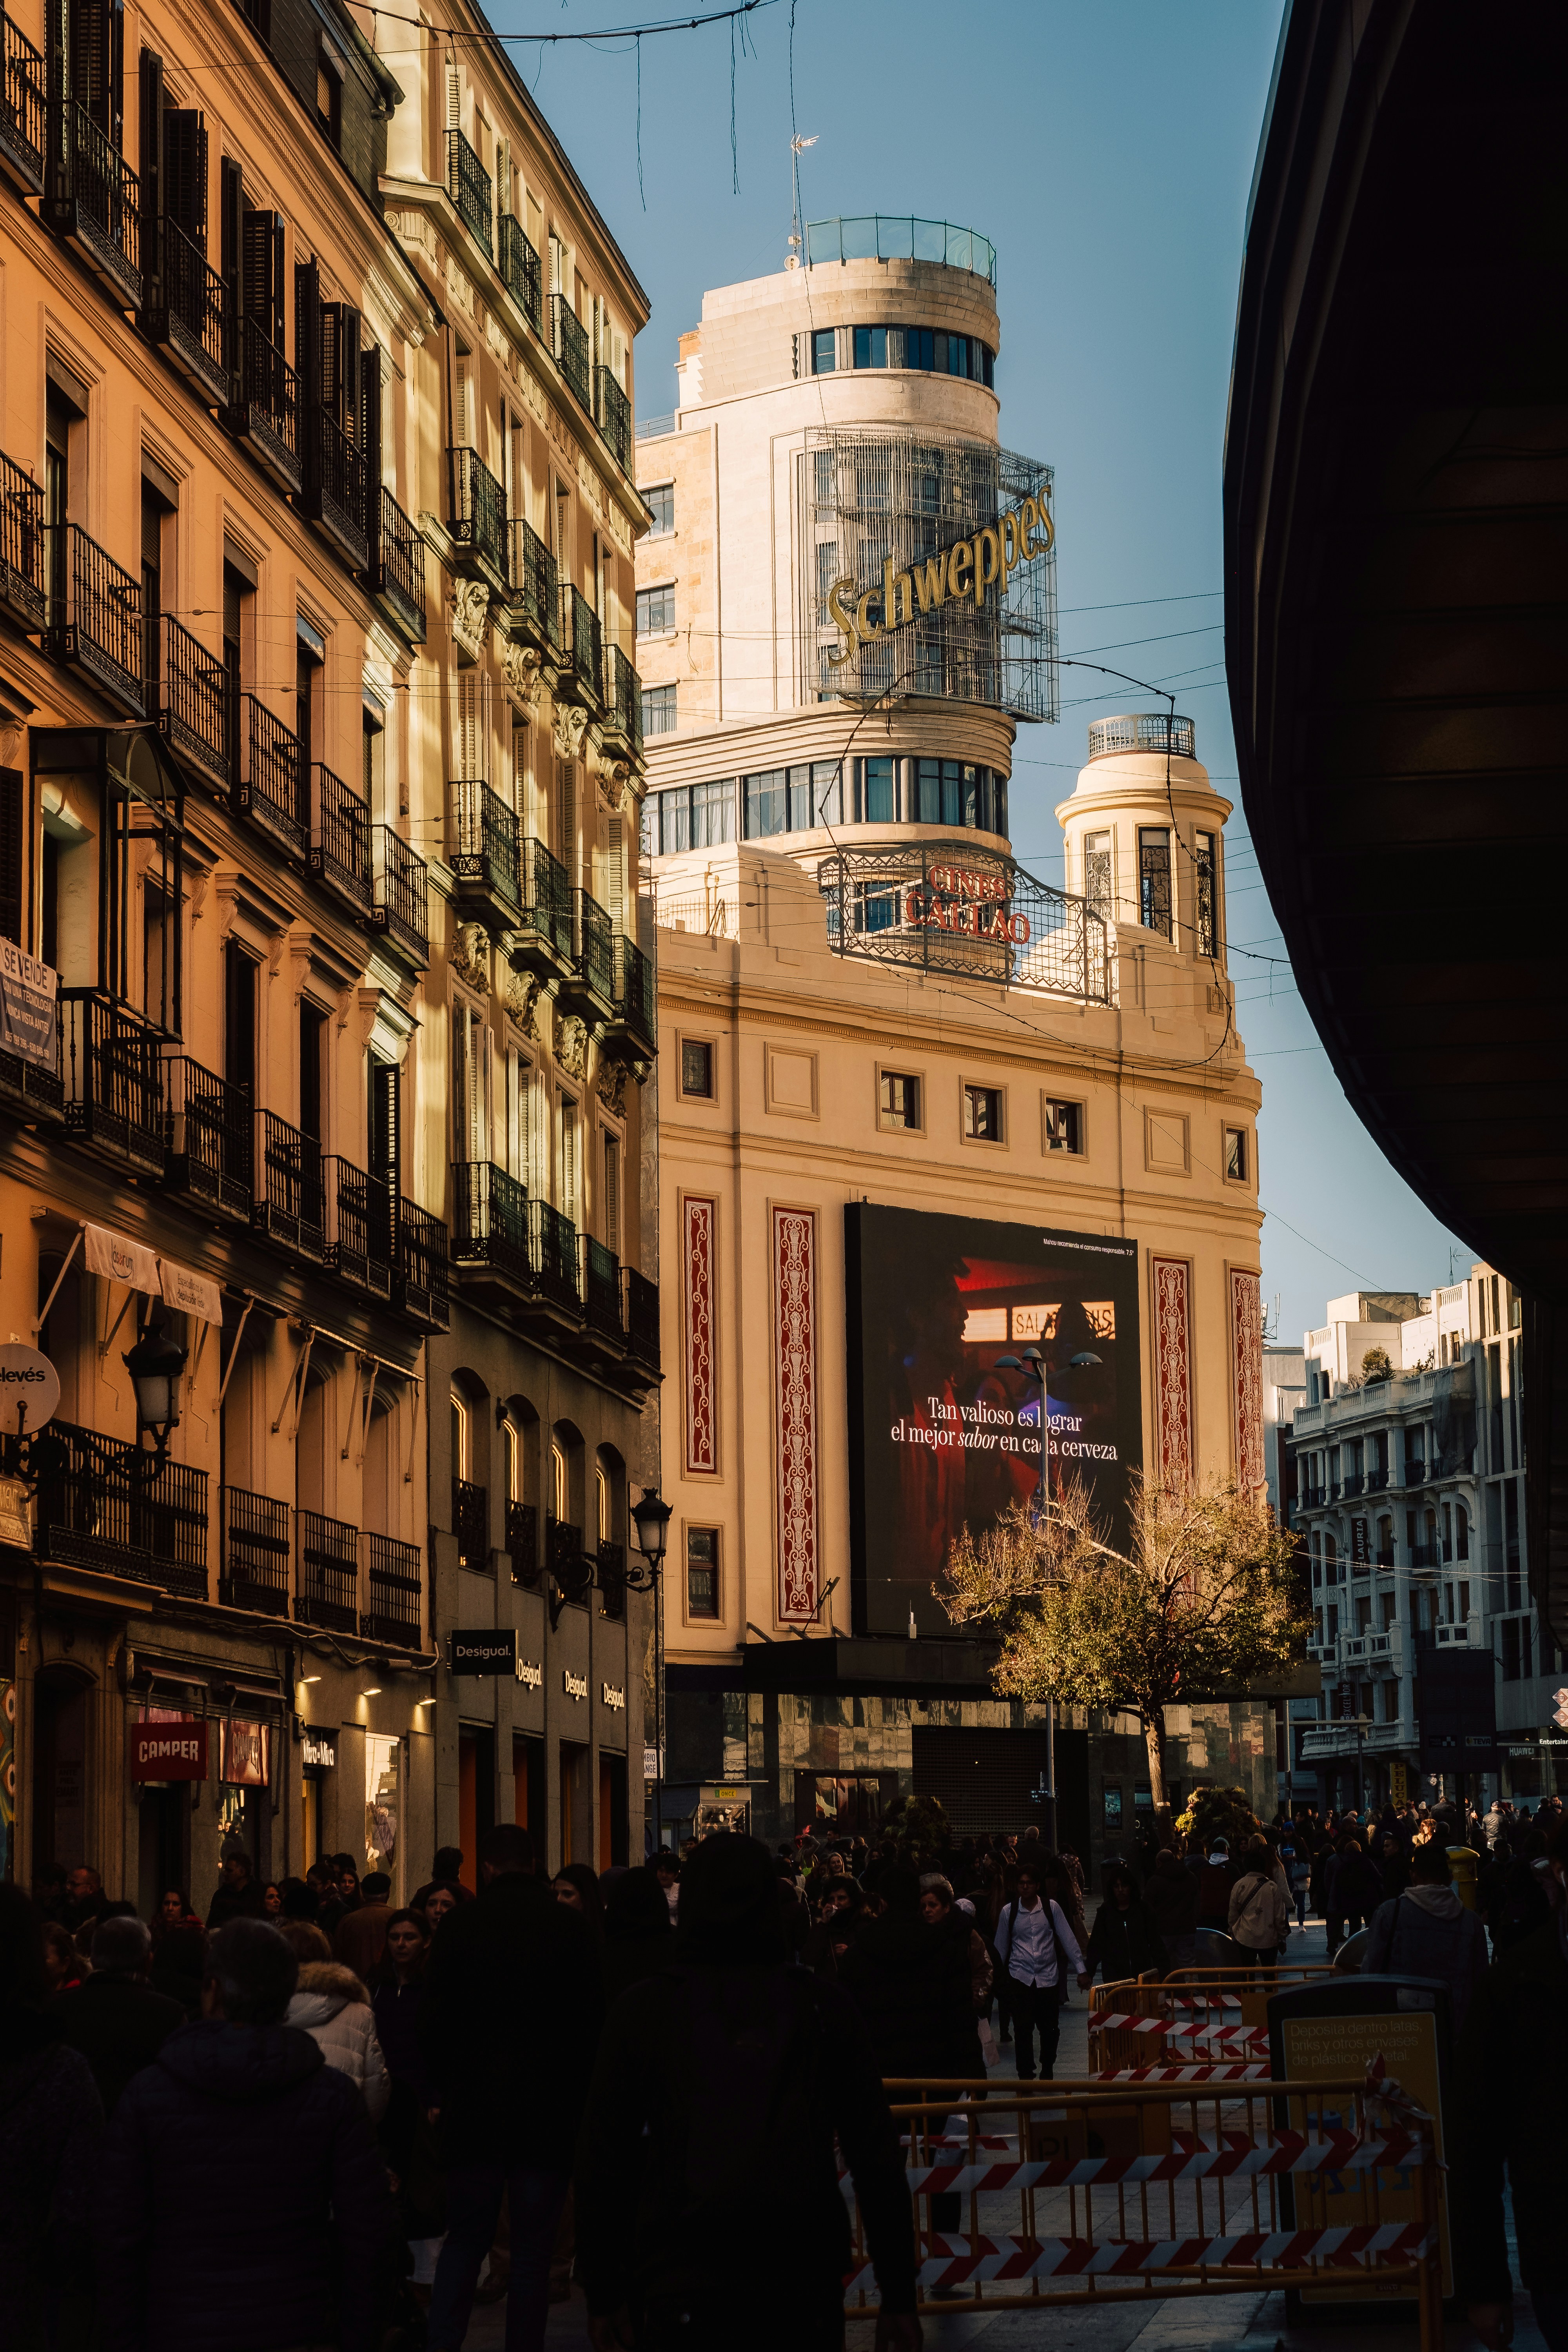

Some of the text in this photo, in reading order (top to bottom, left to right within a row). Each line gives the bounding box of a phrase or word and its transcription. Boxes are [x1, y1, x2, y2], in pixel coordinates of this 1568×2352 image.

[827, 485, 1054, 667] Schweppes
[929, 865, 1005, 900] CINES
[904, 891, 1030, 944] CALLAO
[4, 947, 47, 990] SE VENDE
[0, 1367, 45, 1383] levés
[928, 1397, 957, 1420] Tan
[960, 1400, 1014, 1425] valioso
[1018, 1411, 1033, 1427] es
[891, 1419, 905, 1441] el
[909, 1423, 955, 1450] mejor
[958, 1426, 998, 1449] sabor
[1000, 1436, 1019, 1451] en
[1062, 1441, 1117, 1460] cerveza
[457, 1645, 511, 1659] Desigual.
[519, 1659, 542, 1690] Desigual.
[565, 1670, 587, 1700] Desigual.
[604, 1682, 624, 1711] Desigual.
[139, 1740, 199, 1763] CAMPER
[1291, 2021, 1422, 2038] Deposita dentro latas,
[1292, 2036, 1418, 2053] briks y otros envases
[1293, 2054, 1308, 2066] de
[1312, 2053, 1359, 2069] plástico
